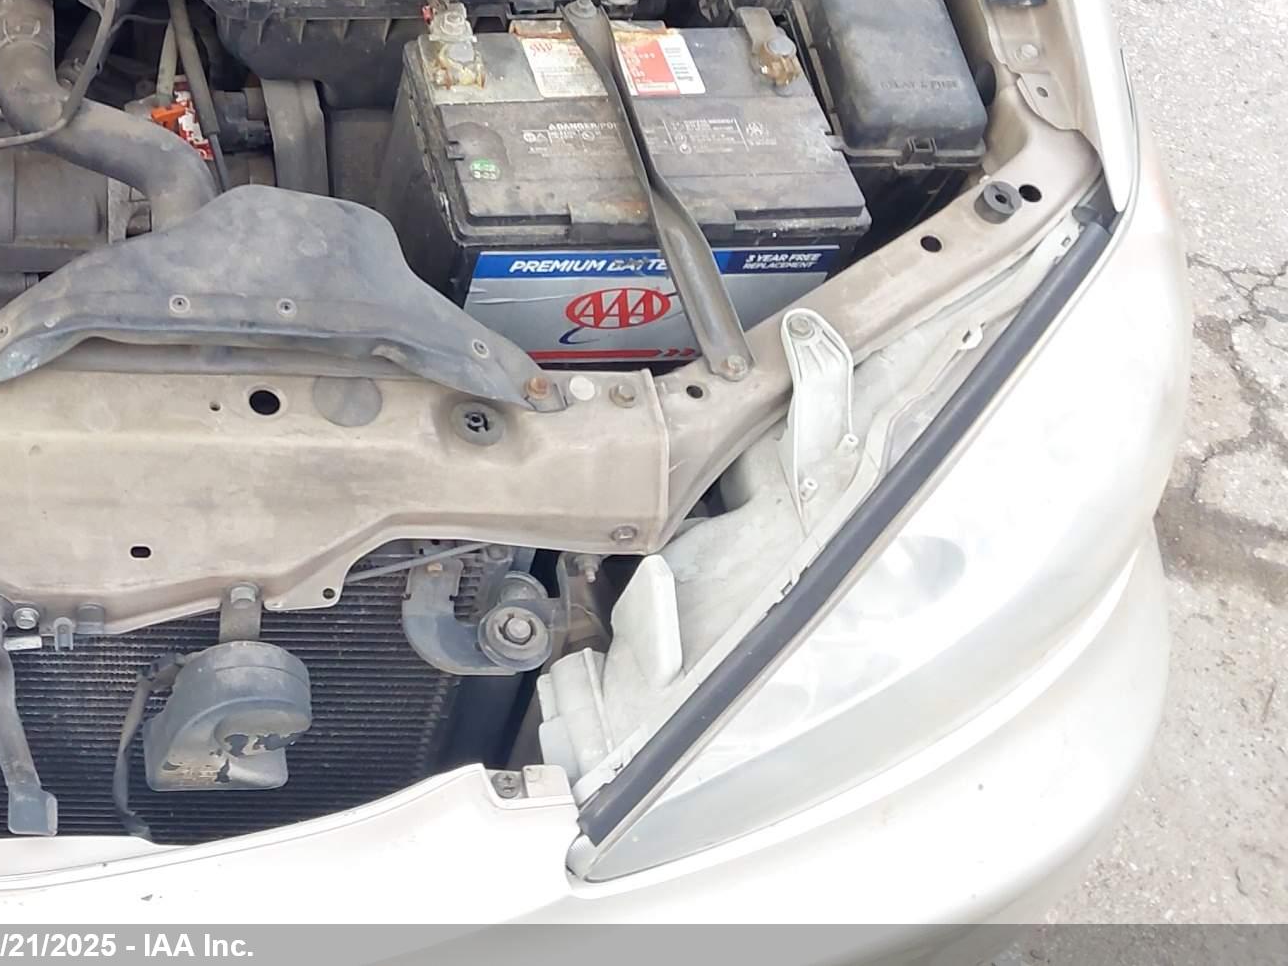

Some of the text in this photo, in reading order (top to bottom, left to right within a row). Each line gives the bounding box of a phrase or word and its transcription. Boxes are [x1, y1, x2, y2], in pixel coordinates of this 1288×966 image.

[745, 253, 823, 263] 3 YEAR FREE
[509, 257, 669, 274] PREMIUM BATTE
[742, 261, 816, 270] REPLACEMENT
[569, 287, 664, 329] AAA
